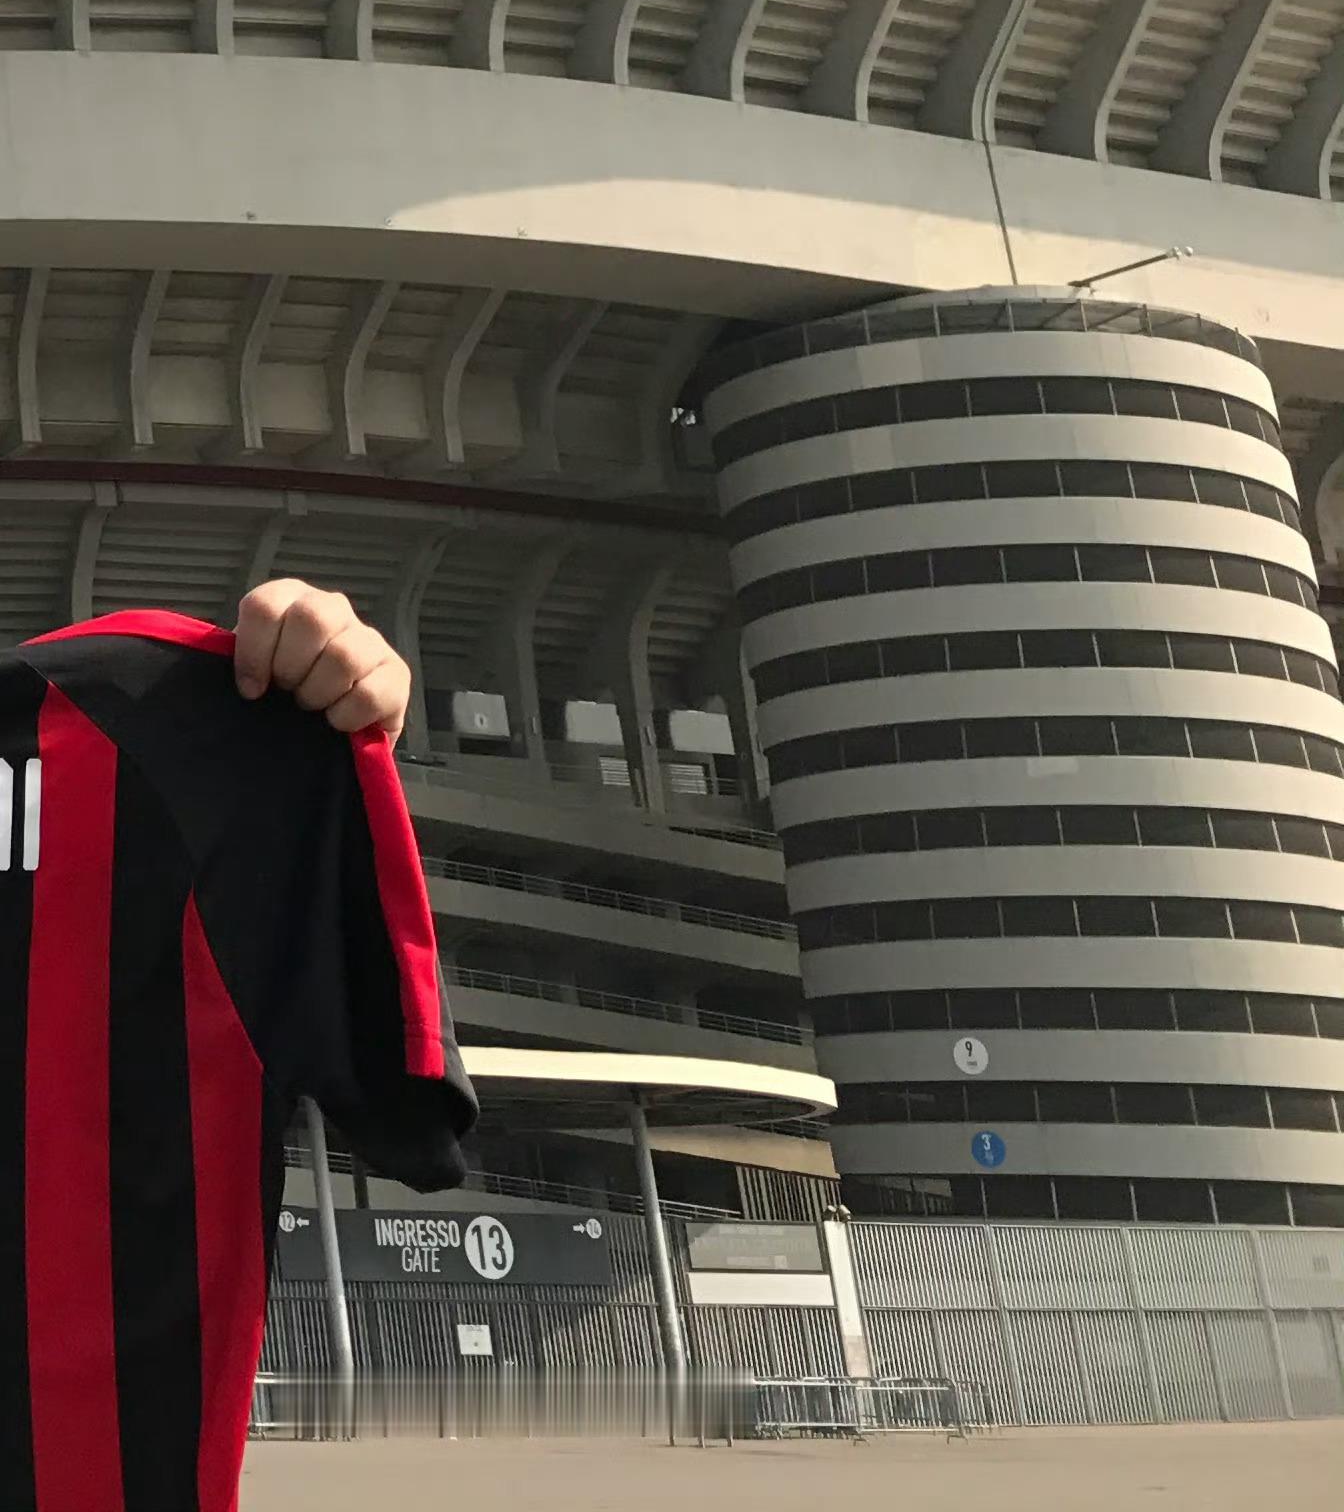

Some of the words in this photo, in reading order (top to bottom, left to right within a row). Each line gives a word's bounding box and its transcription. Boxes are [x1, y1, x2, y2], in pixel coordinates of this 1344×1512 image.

[964, 1040, 973, 1057] 9
[280, 1214, 293, 1230] 12
[374, 1218, 461, 1248] INGRESSO
[401, 1247, 441, 1273] GATE
[471, 1224, 508, 1271] 13
